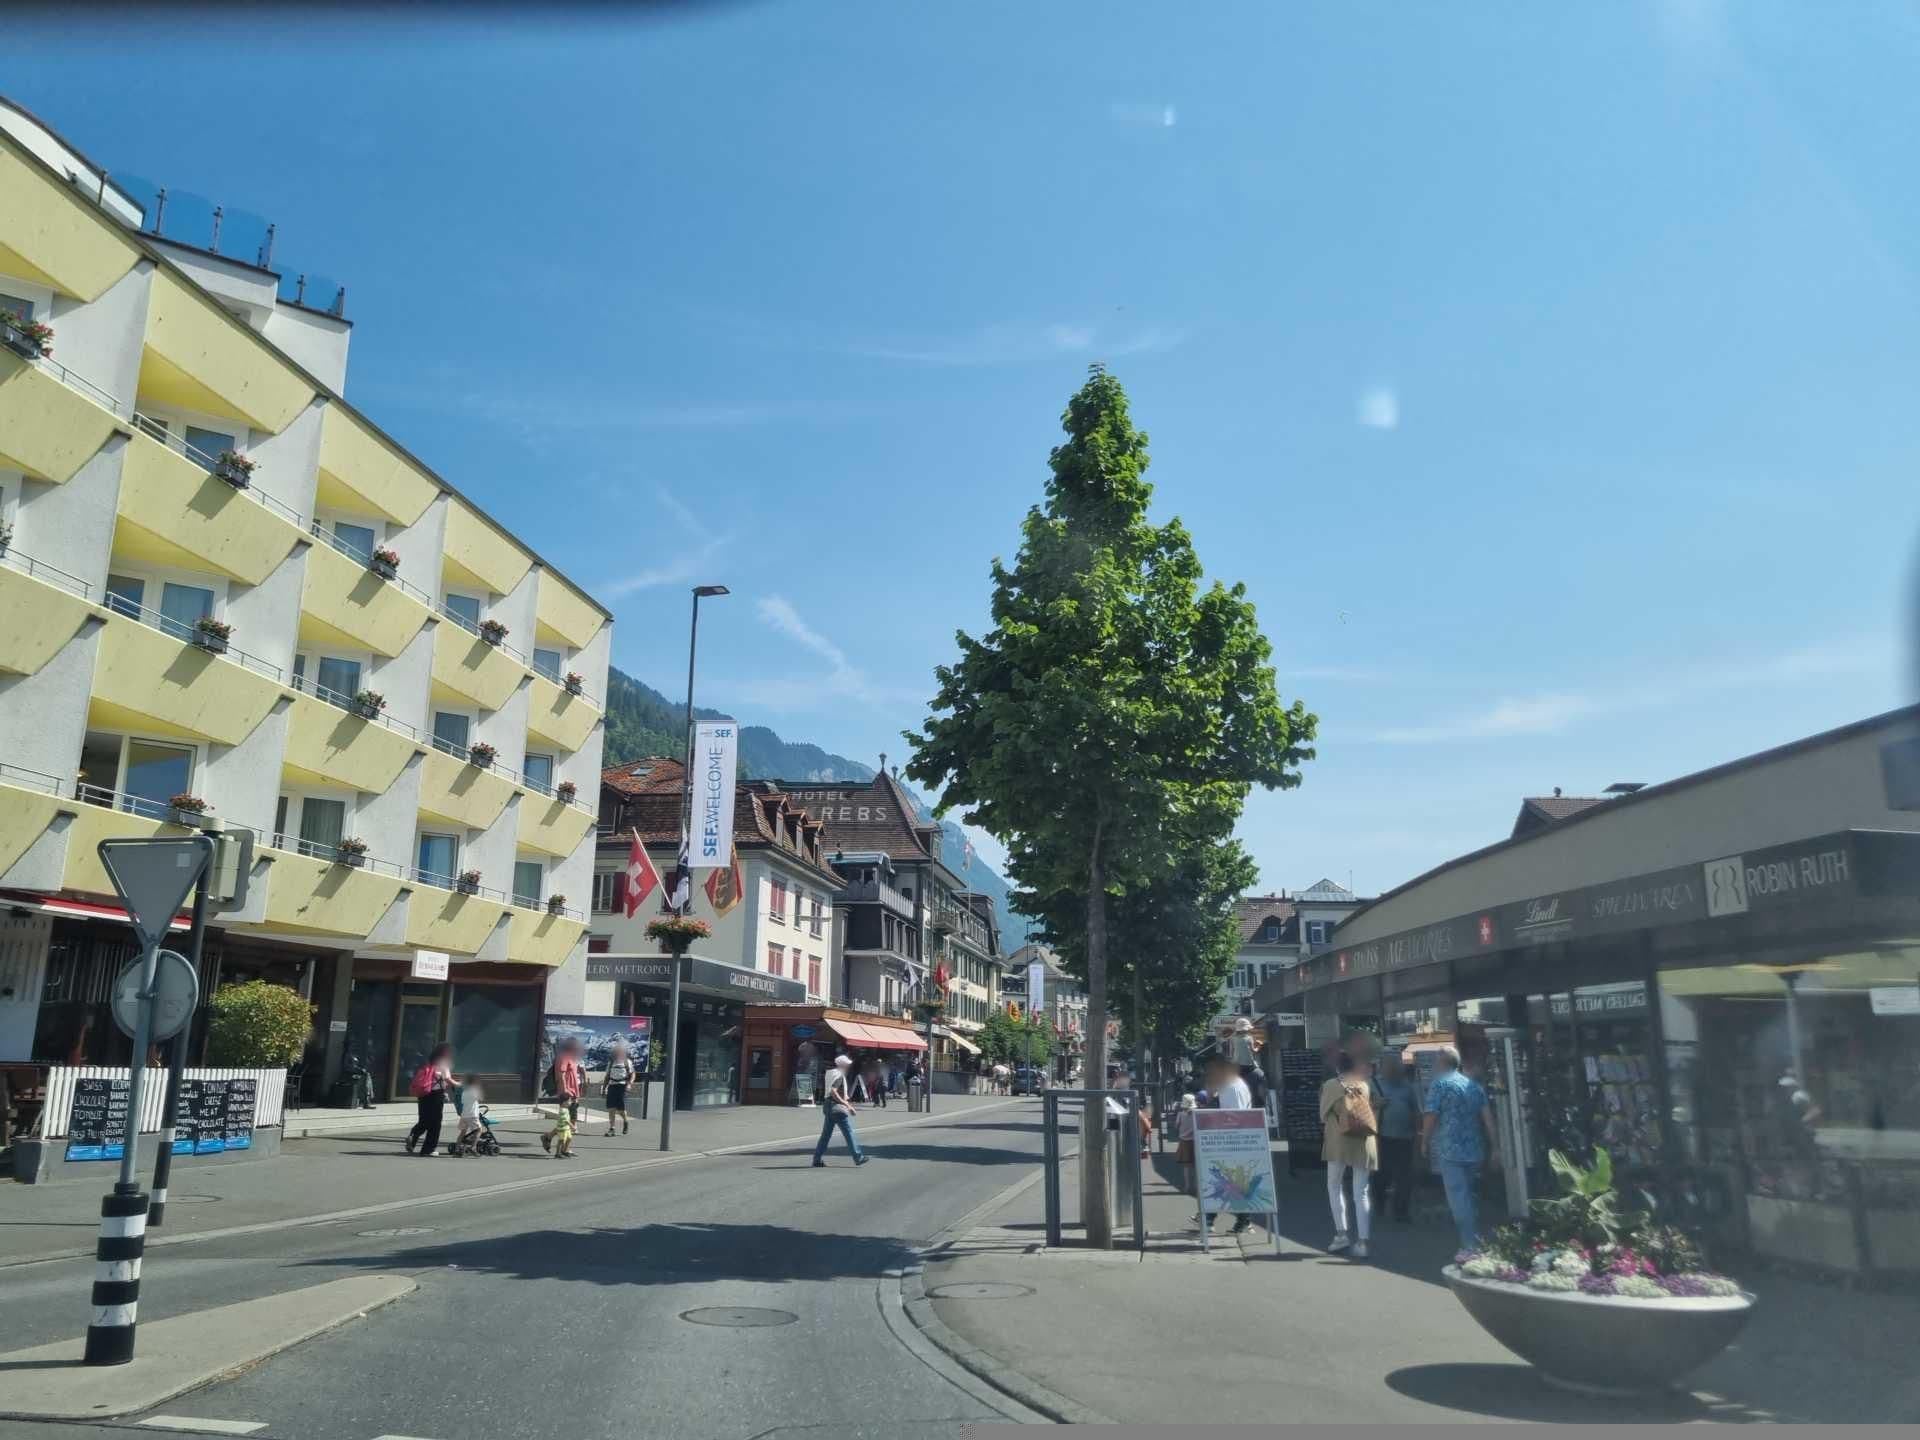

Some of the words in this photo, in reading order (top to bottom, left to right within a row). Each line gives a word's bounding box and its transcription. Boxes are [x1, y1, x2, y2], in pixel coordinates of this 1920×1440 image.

[793, 791, 848, 800] HOTEL
[808, 807, 888, 821] REBS
[1746, 863, 1796, 896] ROBIN
[1800, 849, 1849, 888] RUTH
[614, 963, 673, 975] METROPOL
